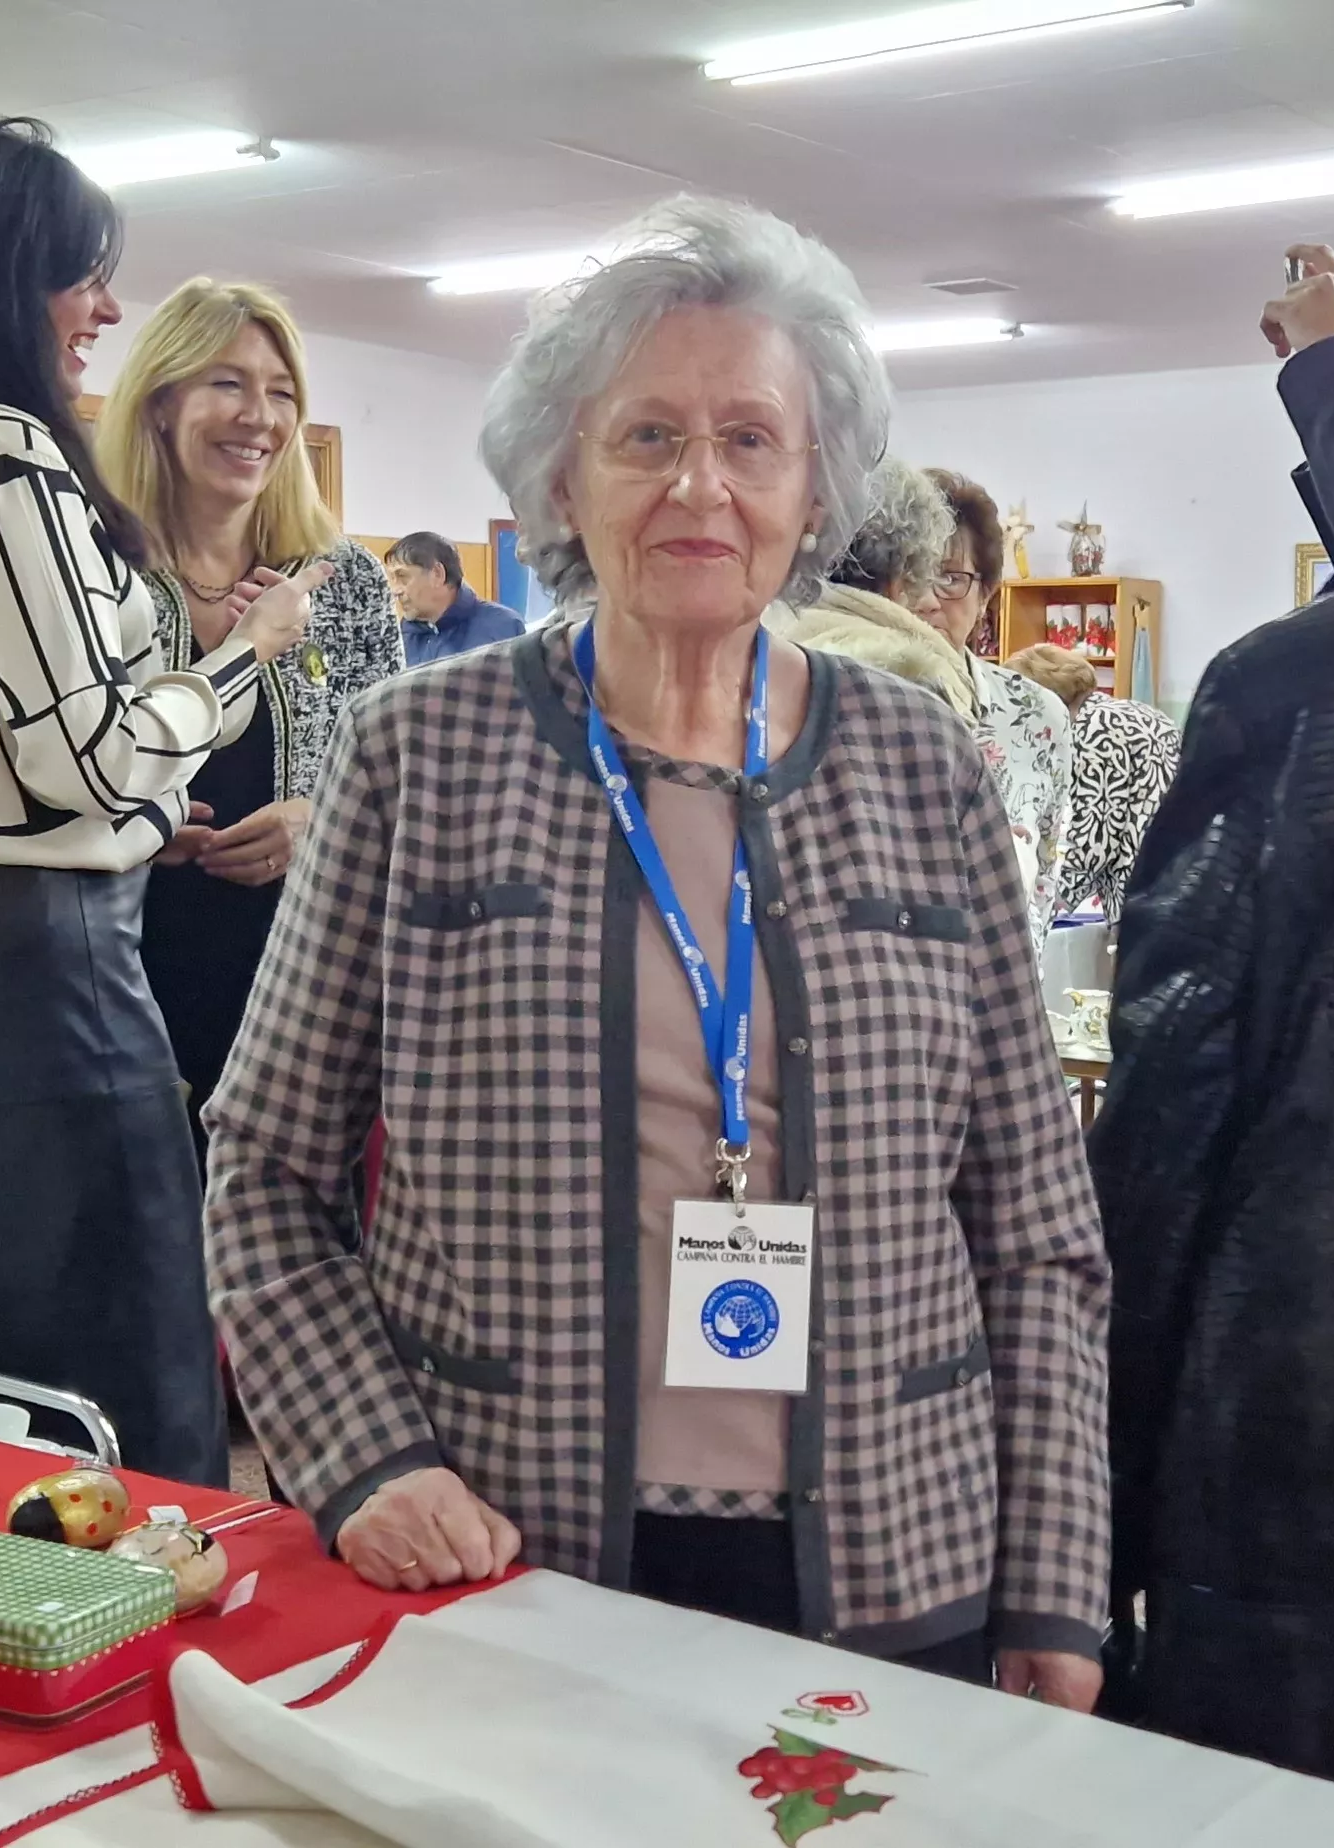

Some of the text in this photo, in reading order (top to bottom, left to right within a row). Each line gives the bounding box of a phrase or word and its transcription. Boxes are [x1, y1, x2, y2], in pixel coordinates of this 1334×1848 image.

[665, 911, 710, 1009] Manos Unidas
[736, 1013, 747, 1057] Unidas
[678, 1236, 807, 1253] Manos Unidas
[720, 1252, 756, 1264] CONTRA
